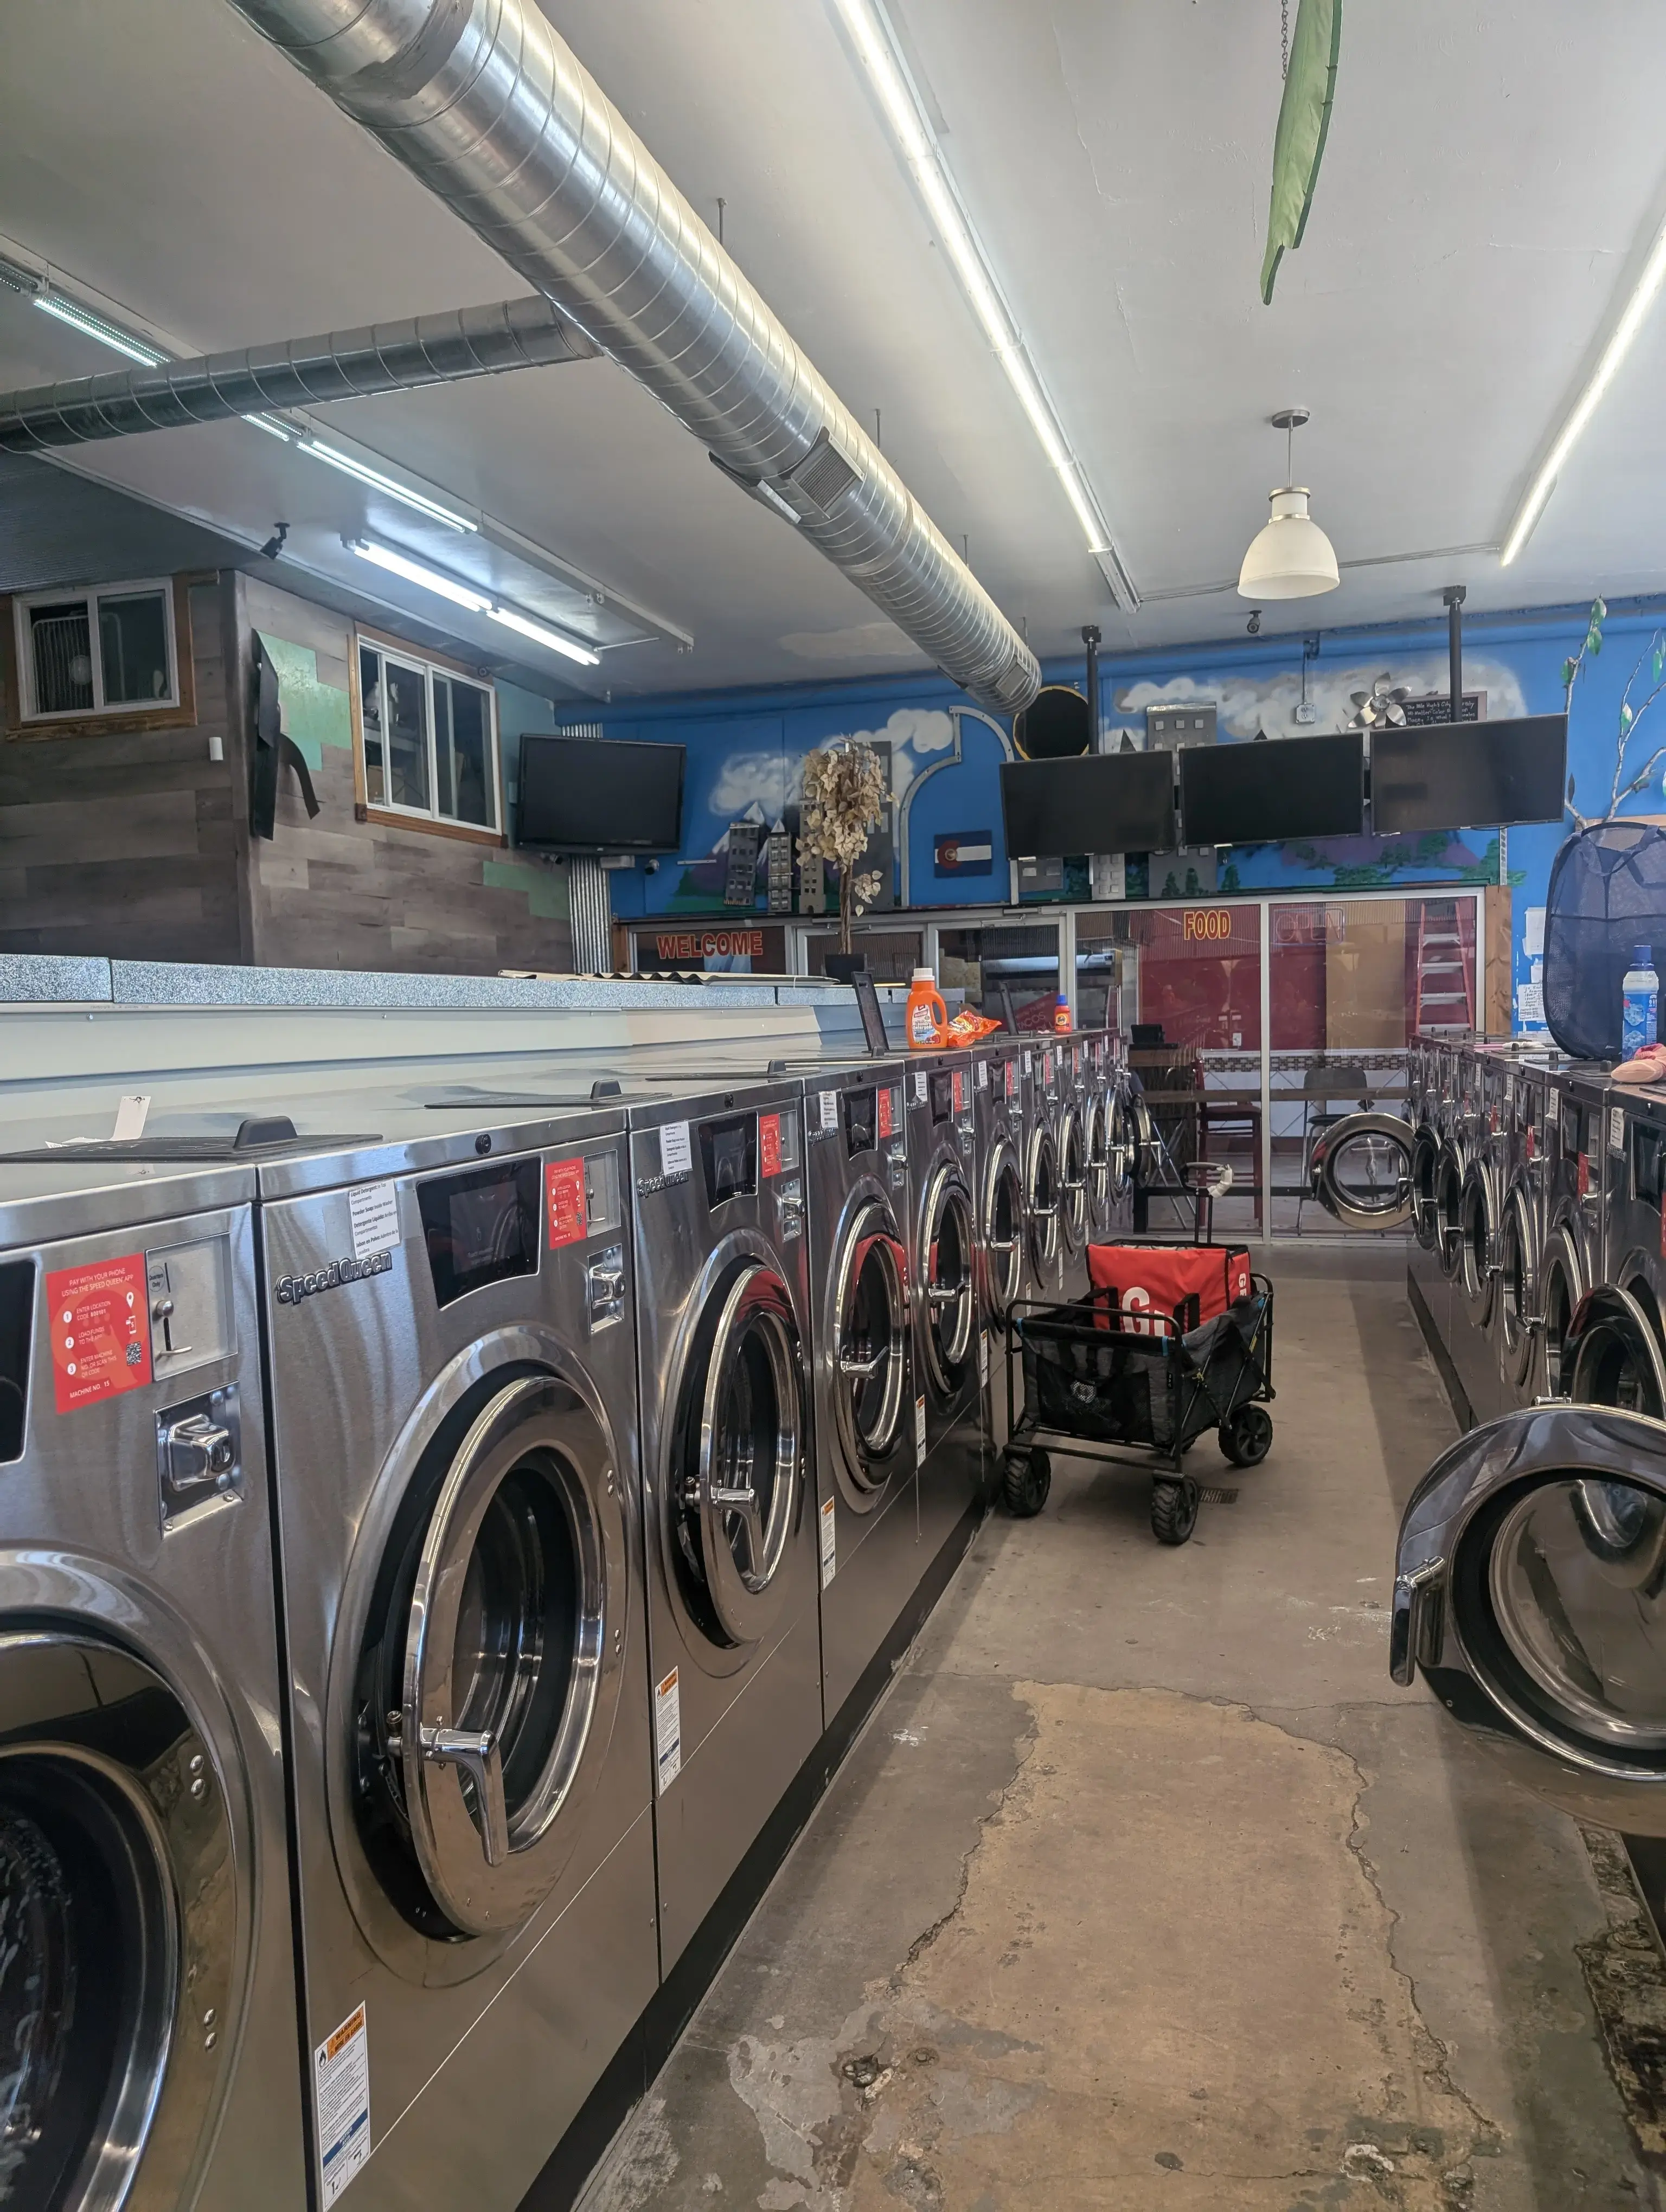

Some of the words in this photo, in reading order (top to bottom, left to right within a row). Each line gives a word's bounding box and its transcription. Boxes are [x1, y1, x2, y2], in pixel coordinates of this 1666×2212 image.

[1183, 910, 1231, 940] FOOD
[656, 931, 763, 959] WELCOME
[1016, 1011, 1046, 1030] TACOS
[351, 1195, 372, 1205] Compartments
[354, 1218, 372, 1229] Detergente
[80, 1275, 93, 1284] WITH
[94, 1272, 108, 1281] YOUR
[108, 1268, 125, 1277] PHONE
[61, 1287, 79, 1297] USING
[89, 1281, 105, 1290] SPEED
[76, 1306, 90, 1314] ENTER
[90, 1301, 111, 1310] LOCATION
[78, 1329, 91, 1338] LOAD
[90, 1326, 105, 1335] FUNDS
[94, 1349, 113, 1359] MACHINE
[96, 1359, 107, 1367] SCAN
[69, 1385, 92, 1398] MACHINE
[336, 2011, 361, 2040] WARNING
